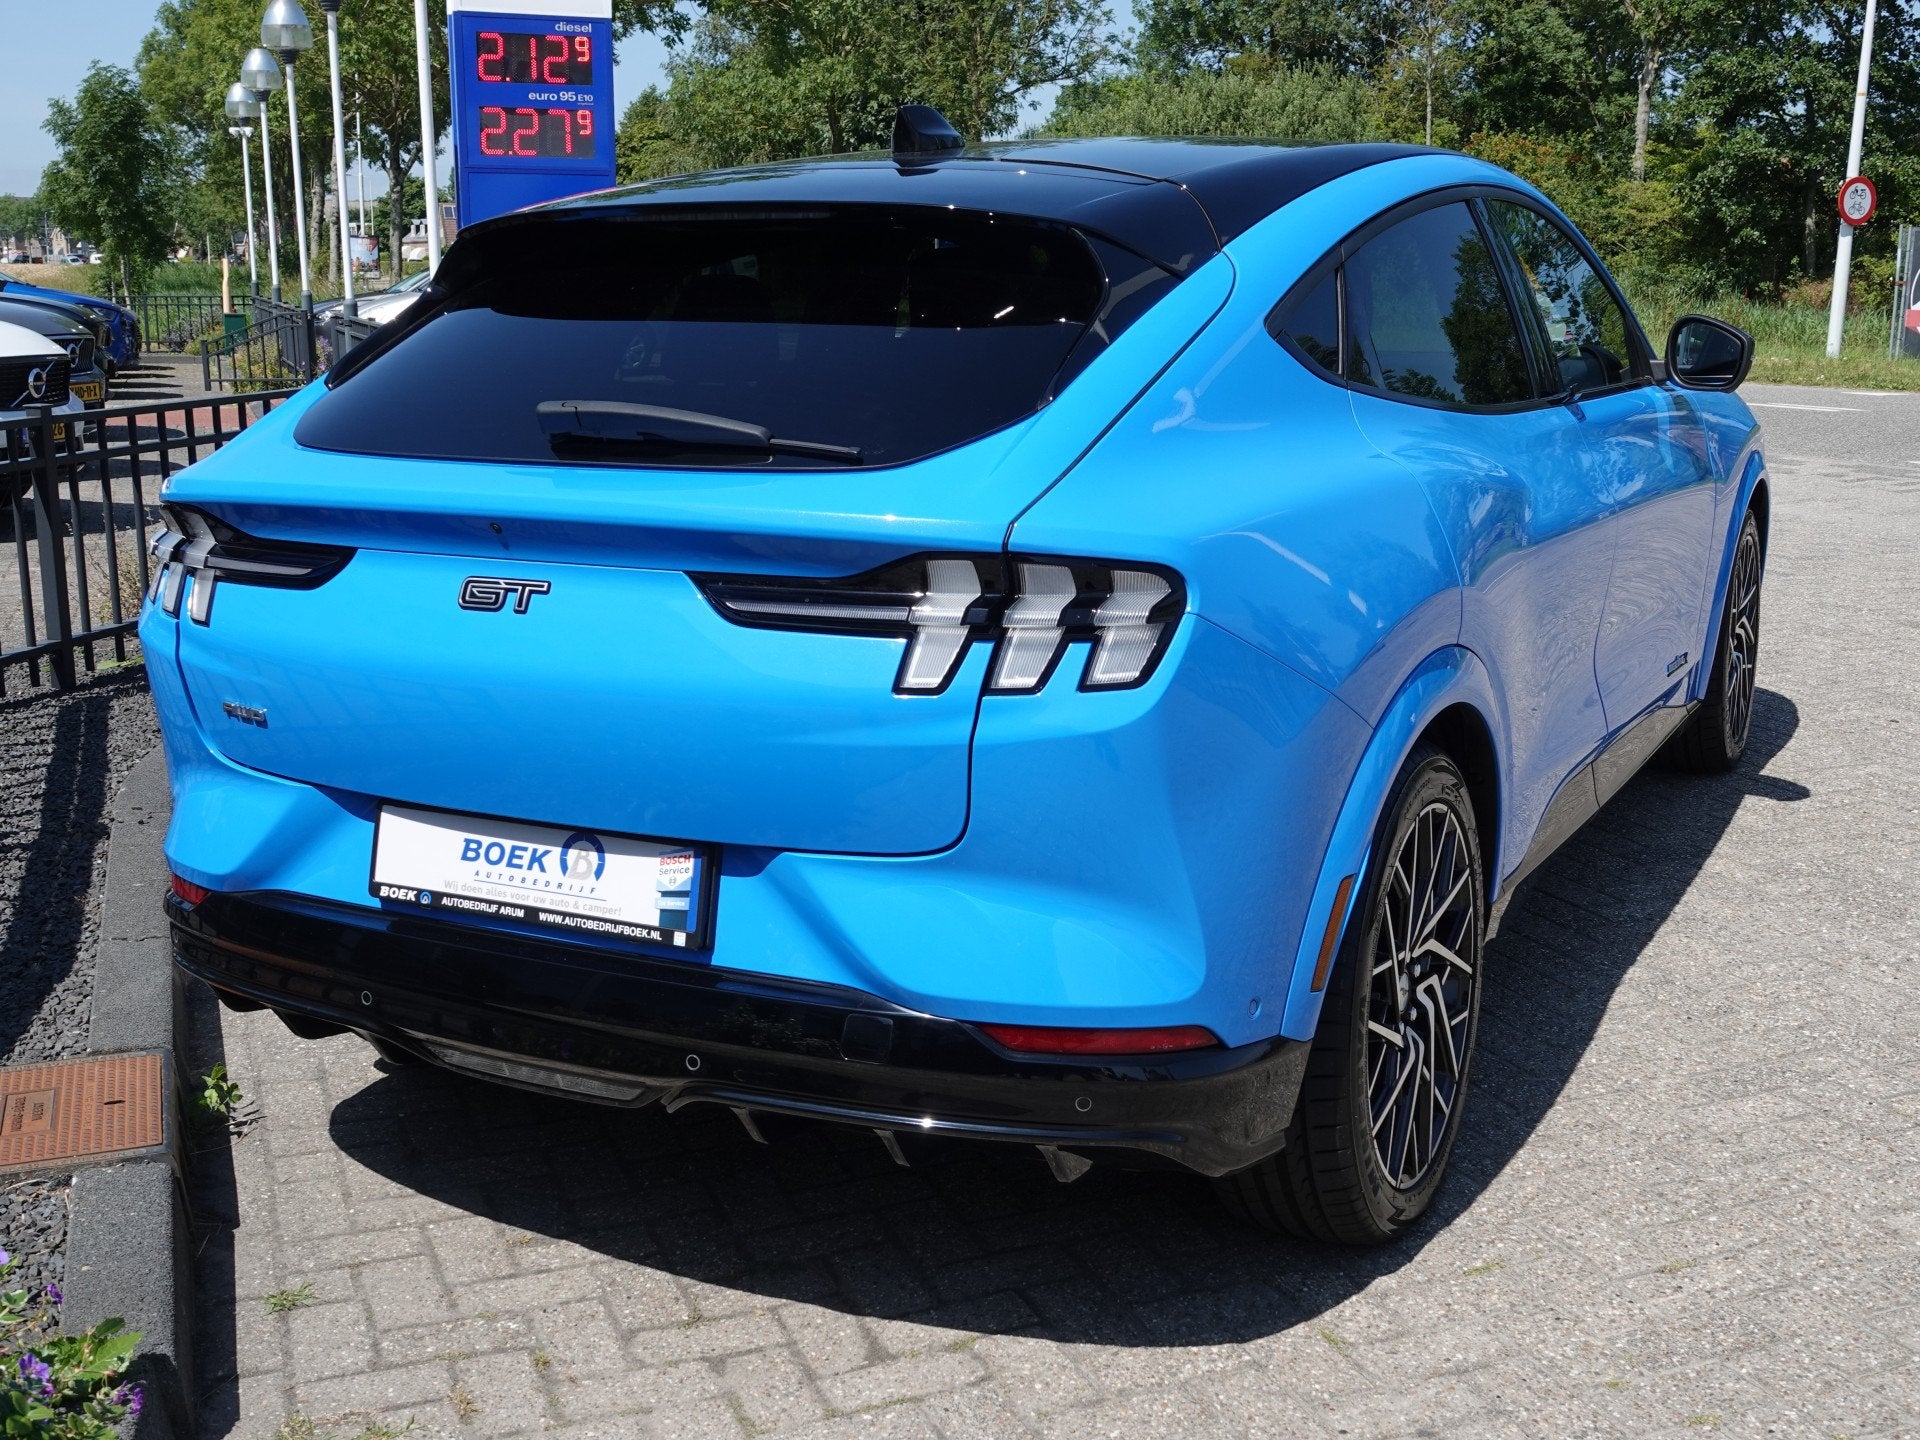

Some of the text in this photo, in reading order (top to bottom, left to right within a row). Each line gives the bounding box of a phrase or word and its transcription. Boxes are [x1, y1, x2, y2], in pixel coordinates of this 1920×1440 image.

[555, 22, 592, 33] diesel
[528, 92, 557, 101] euro
[559, 91, 576, 102] 95
[458, 575, 552, 615] GT
[460, 838, 552, 874] BOEK
[659, 854, 692, 867] BOSCH
[474, 870, 597, 894] AUTOBEDRIJF
[659, 866, 690, 876] Service
[444, 880, 622, 917] Wij doen alles voor uw auto & camper!
[380, 886, 418, 901] BOEK
[441, 896, 499, 913] AUTOBEDRIJF
[499, 906, 525, 918] ARUM
[538, 911, 662, 940] WWW.AUTOBEDRIJFBOEK.NL
